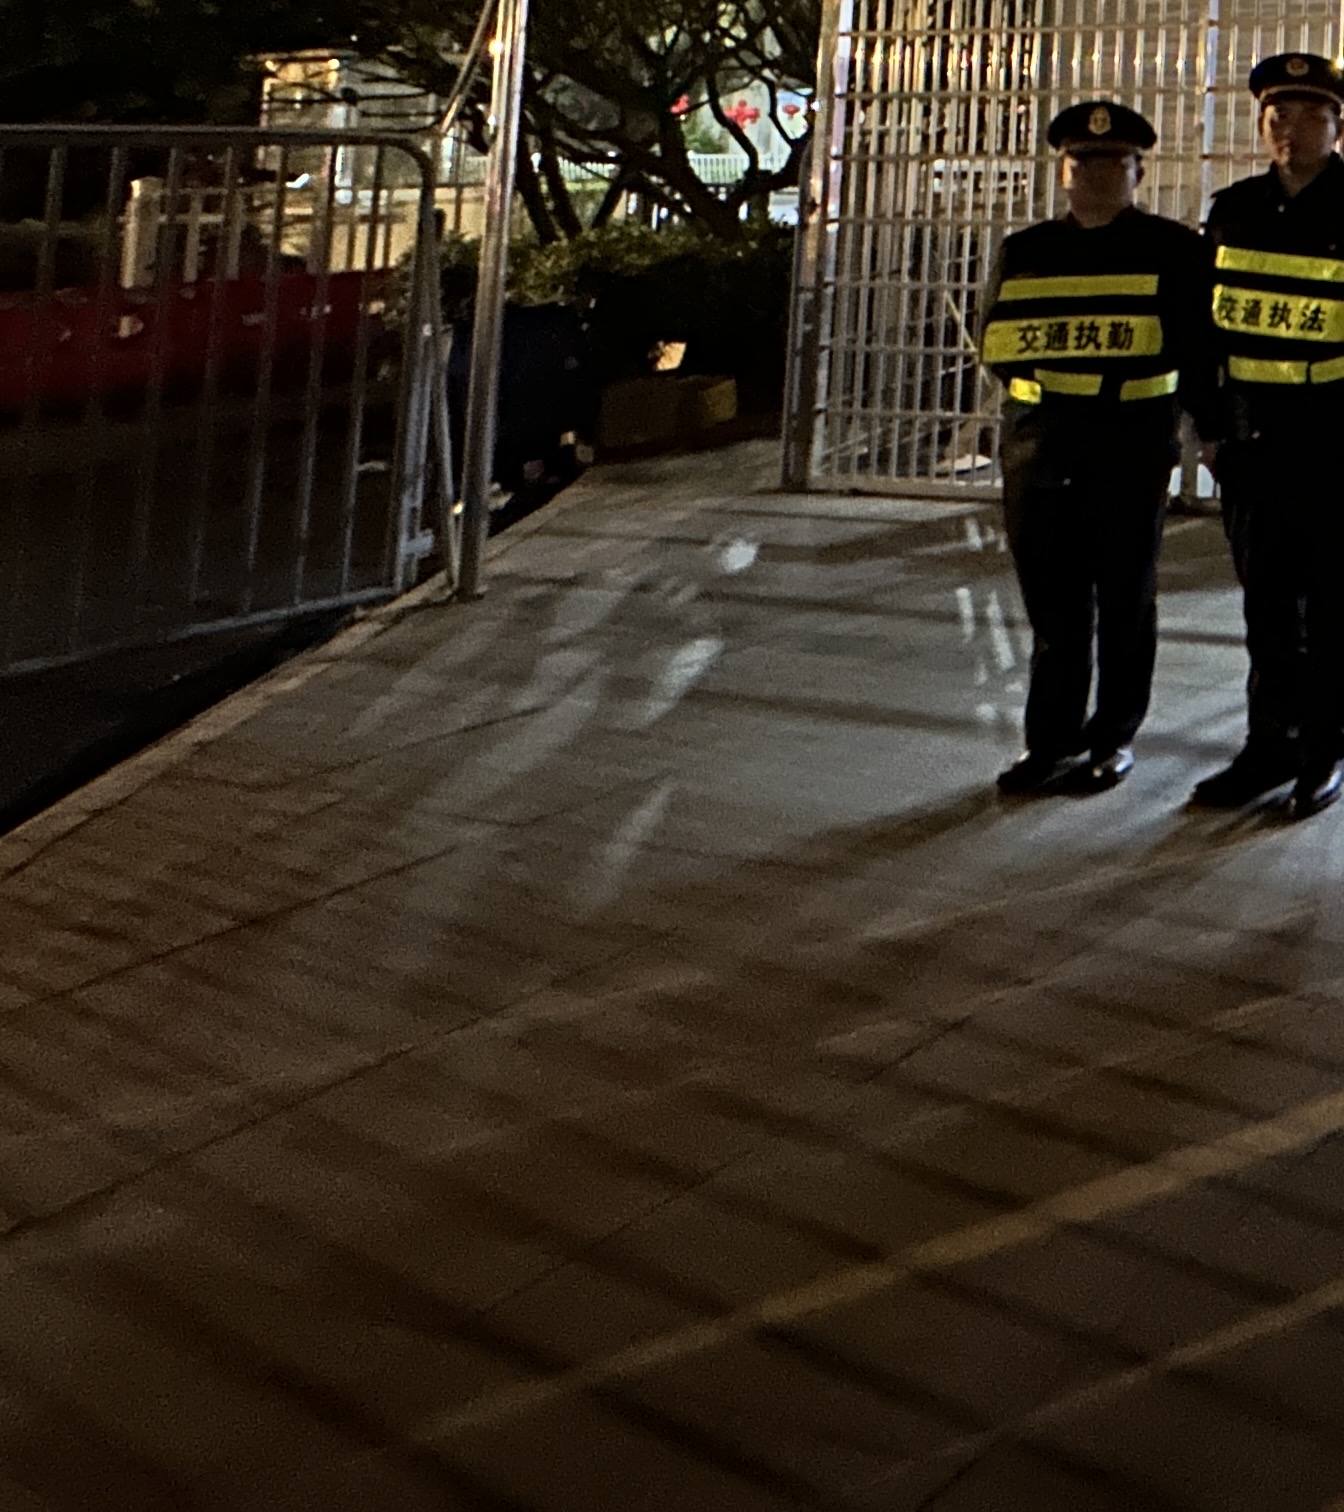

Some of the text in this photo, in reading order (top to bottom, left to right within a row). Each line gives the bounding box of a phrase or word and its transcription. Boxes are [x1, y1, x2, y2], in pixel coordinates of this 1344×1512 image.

[1218, 294, 1327, 331] 交通执法
[1017, 319, 1135, 354] 交通执勤
